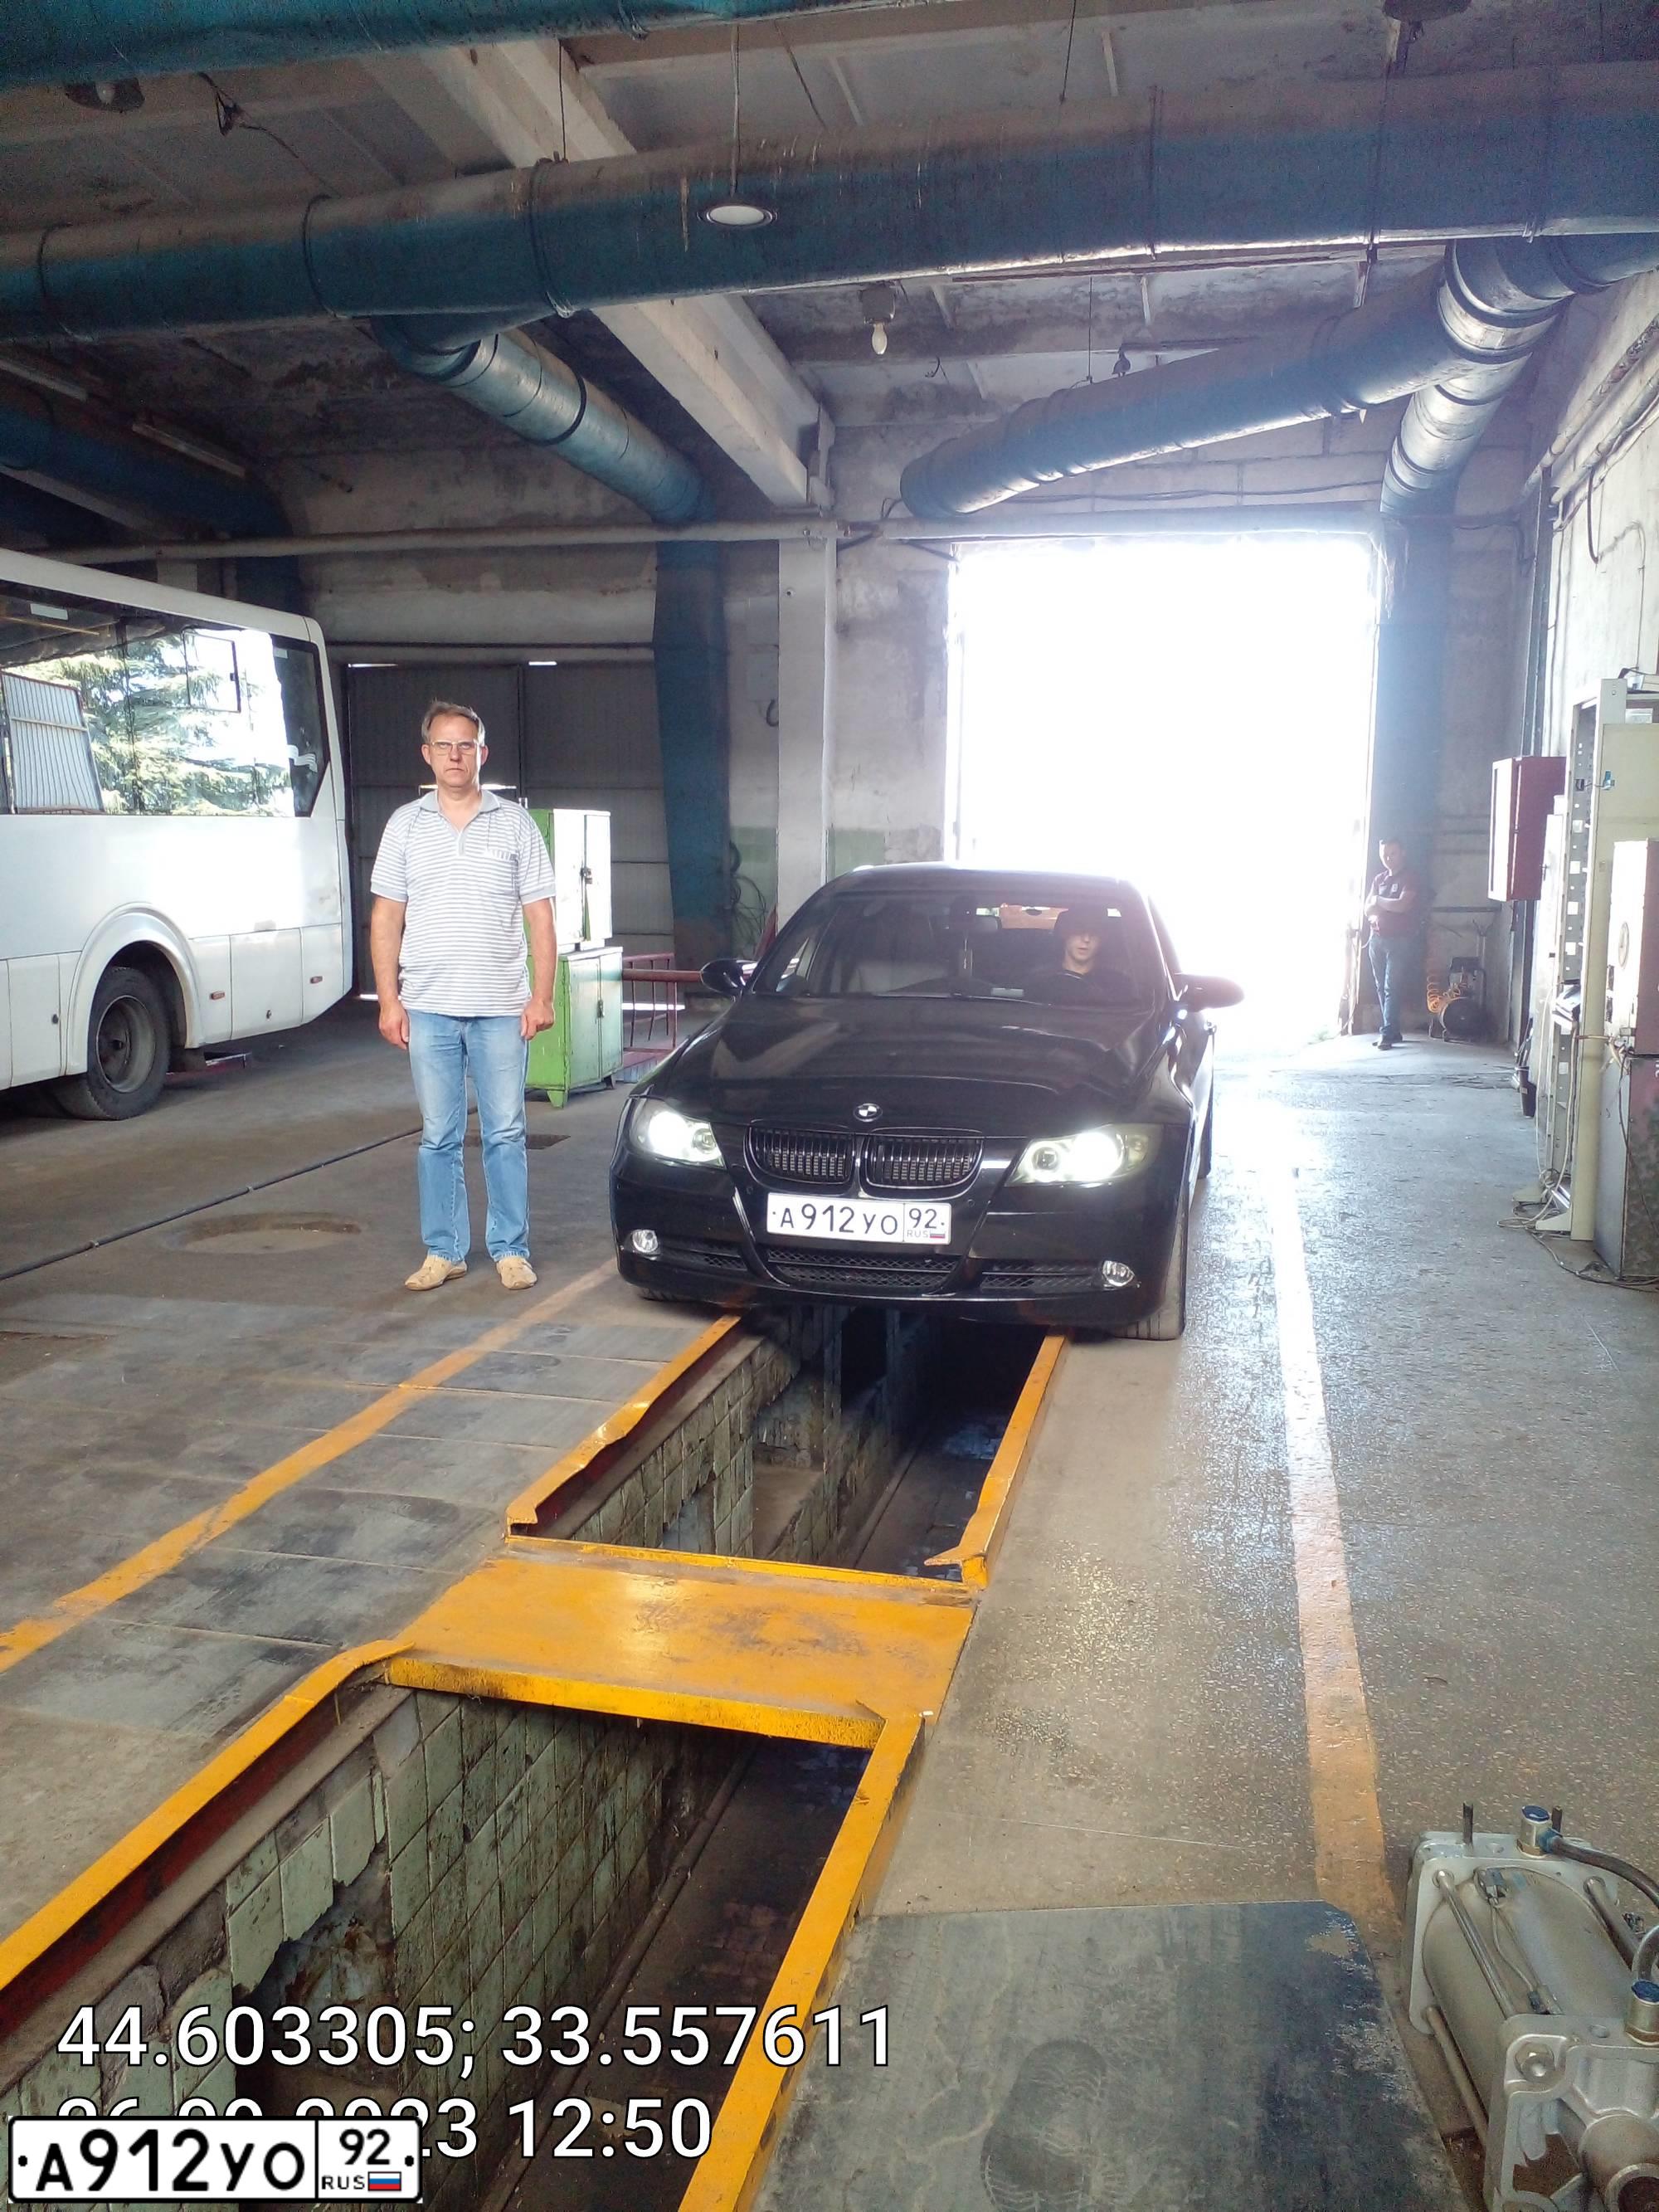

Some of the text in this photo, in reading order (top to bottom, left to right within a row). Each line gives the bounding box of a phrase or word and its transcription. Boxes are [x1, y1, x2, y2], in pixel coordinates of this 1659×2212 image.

[780, 1203, 898, 1235] А912УО
[909, 1208, 937, 1229] 92
[907, 1229, 929, 1238] RUS
